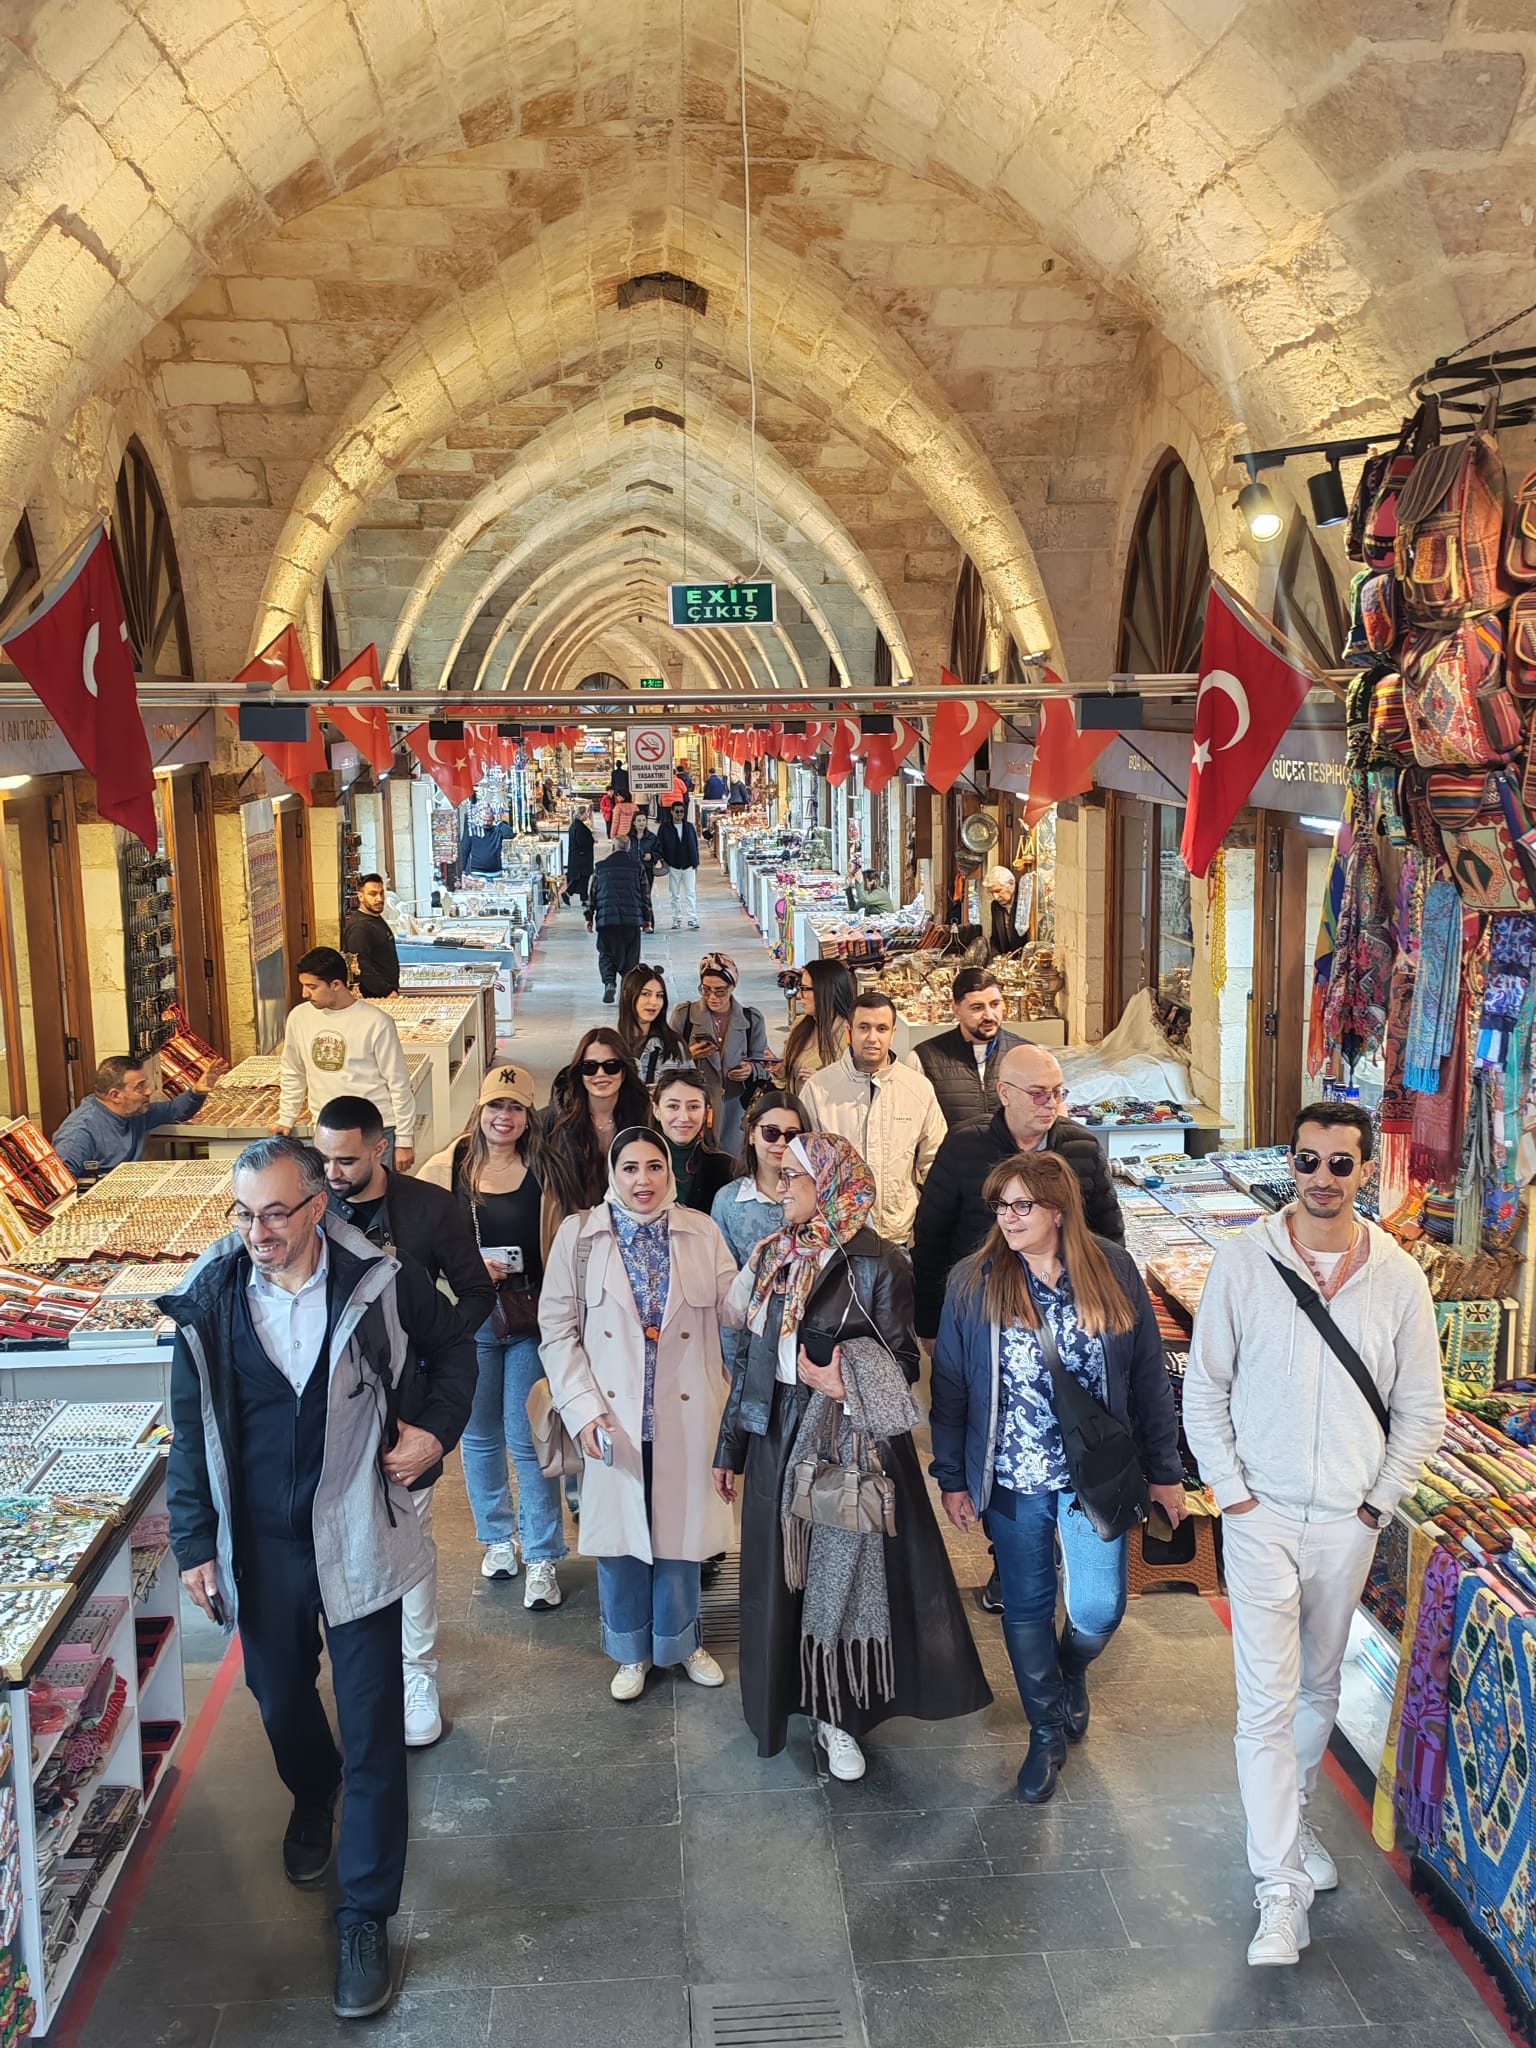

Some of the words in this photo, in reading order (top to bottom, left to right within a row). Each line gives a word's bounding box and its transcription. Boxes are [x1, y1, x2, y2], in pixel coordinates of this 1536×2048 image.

[686, 588, 759, 604] EXIT
[687, 605, 759, 621] ÇIKIŞ
[1272, 754, 1305, 784] GÜÇER
[498, 1068, 517, 1084] NY
